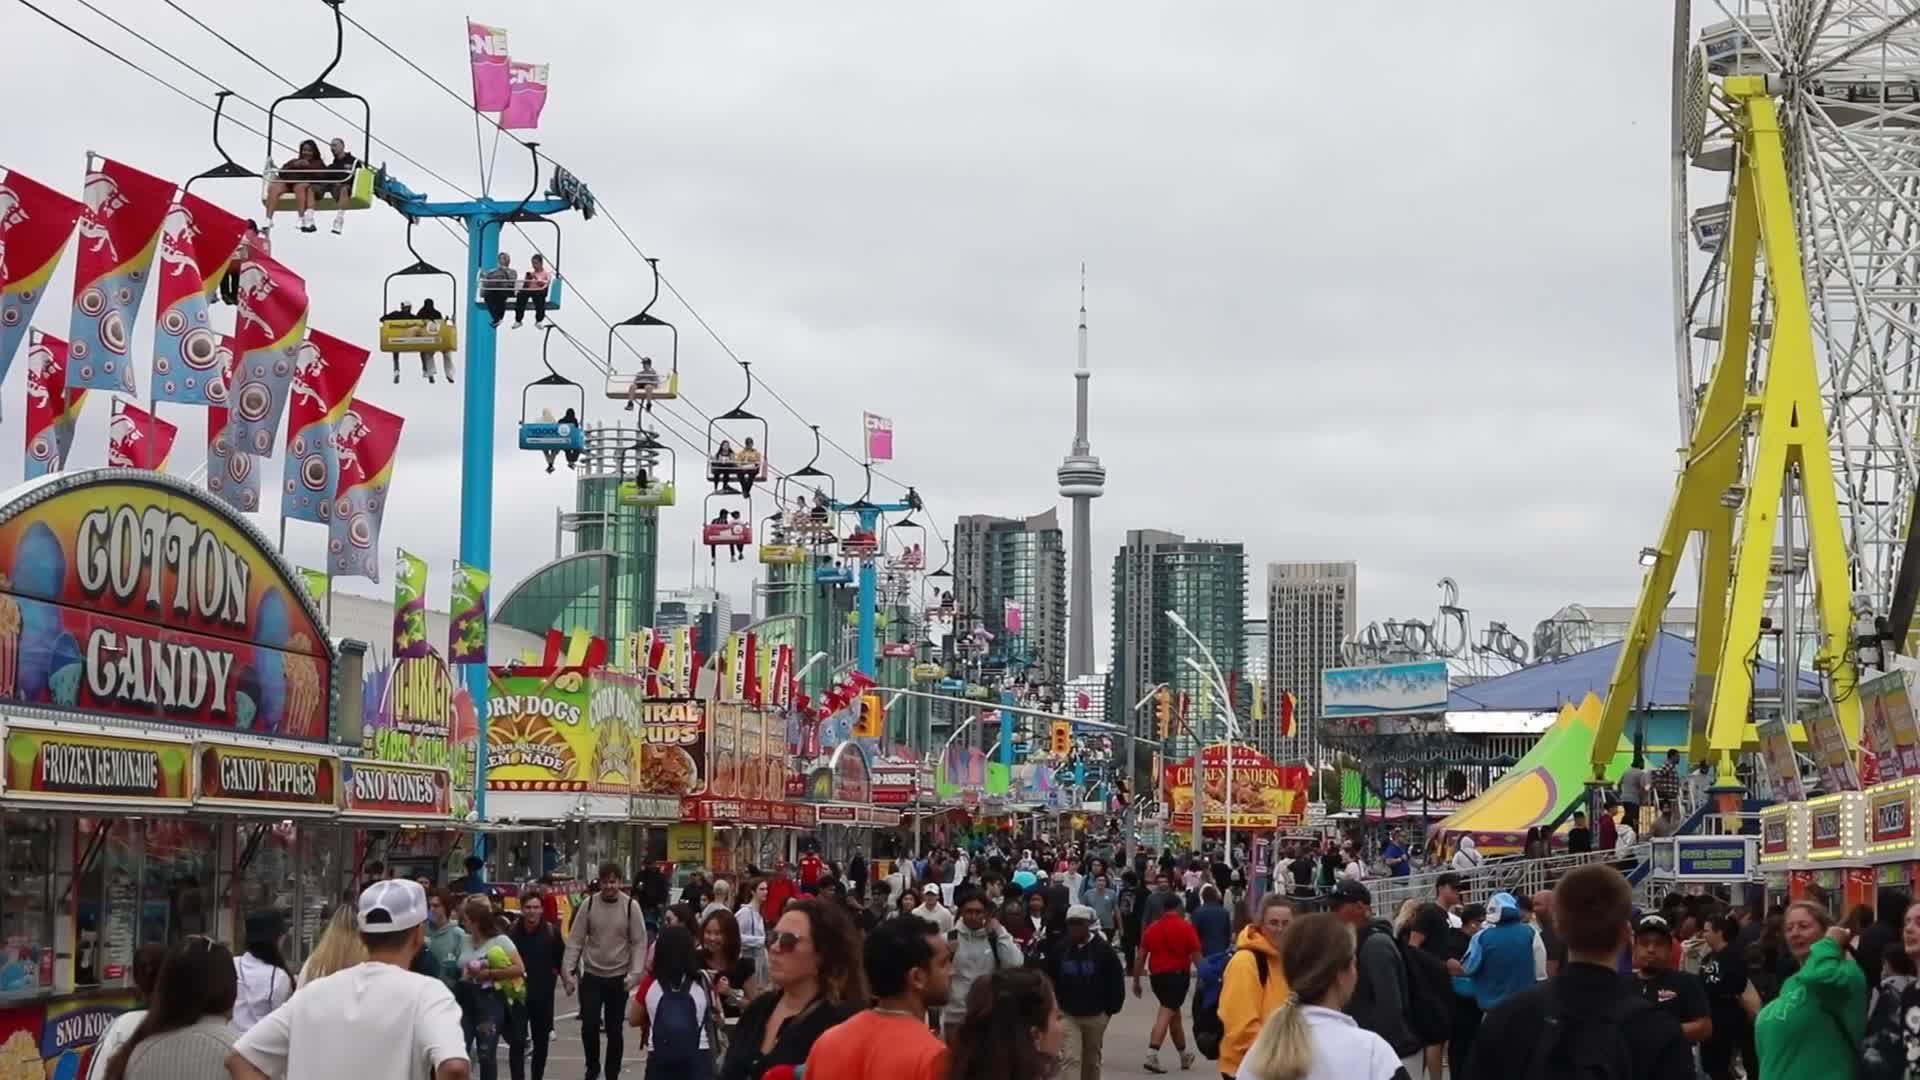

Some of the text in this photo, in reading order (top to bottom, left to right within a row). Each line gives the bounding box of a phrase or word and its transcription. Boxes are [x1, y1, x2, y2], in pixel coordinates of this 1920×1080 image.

[77, 504, 249, 624] COTTON
[87, 627, 233, 712] CANDY
[736, 638, 745, 694] FRIES
[527, 696, 580, 725] DOGS
[644, 704, 699, 722] IRAL
[641, 726, 697, 743] PUDS
[43, 743, 158, 789] FROZEN LEMONADE
[221, 756, 317, 796] CANDY APPLES
[1177, 767, 1279, 786] CHKEN TENDERS
[355, 768, 433, 803] SNO KONES
[56, 1012, 113, 1047] SNO KON
